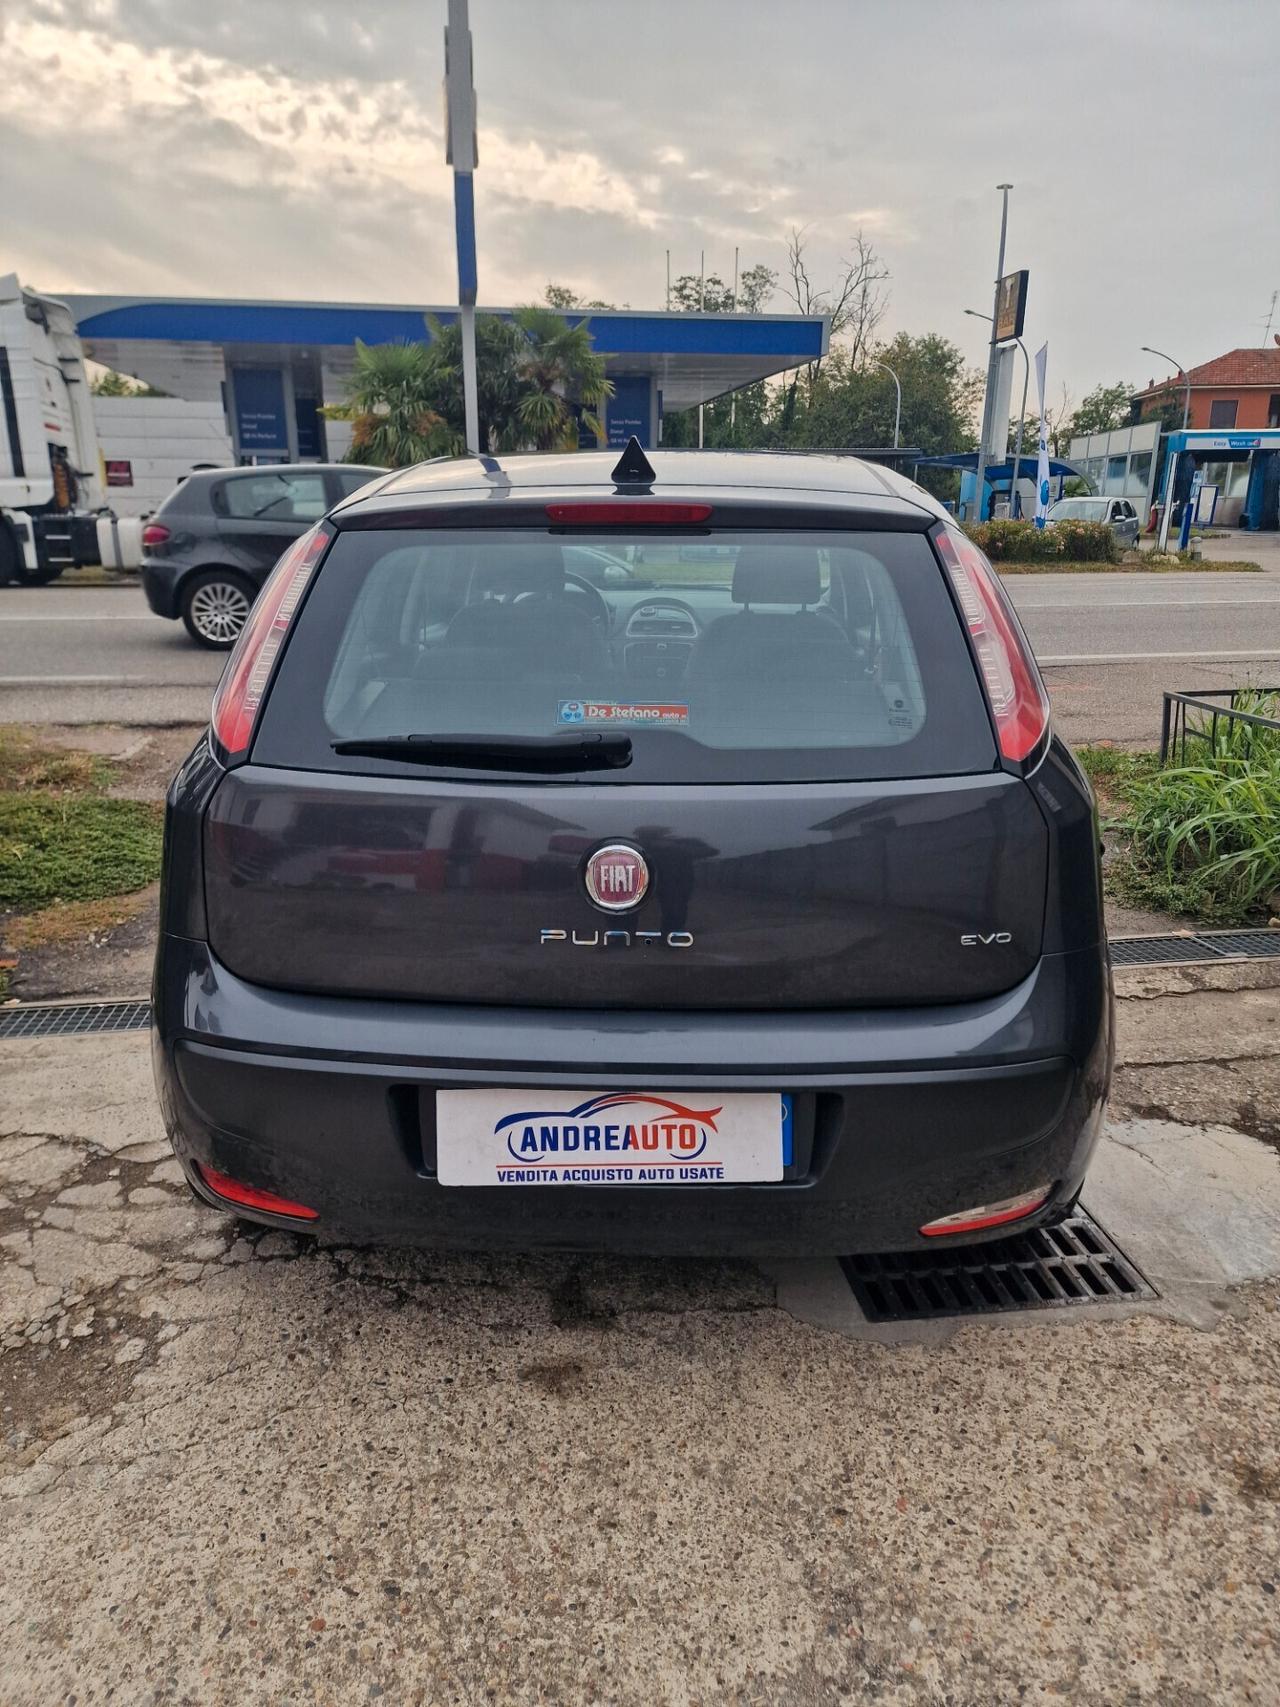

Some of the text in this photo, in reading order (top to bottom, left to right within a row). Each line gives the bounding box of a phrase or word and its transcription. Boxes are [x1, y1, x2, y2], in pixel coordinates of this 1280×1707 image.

[588, 705, 607, 718] De
[610, 705, 660, 718] Stefano
[600, 864, 636, 893] FIAT
[540, 929, 694, 947] PUNTO
[960, 932, 1012, 946] EVO
[520, 1124, 696, 1152] ANDREAUTO
[497, 1167, 724, 1182] VENDITA ACQUISTO AUTO USATE
